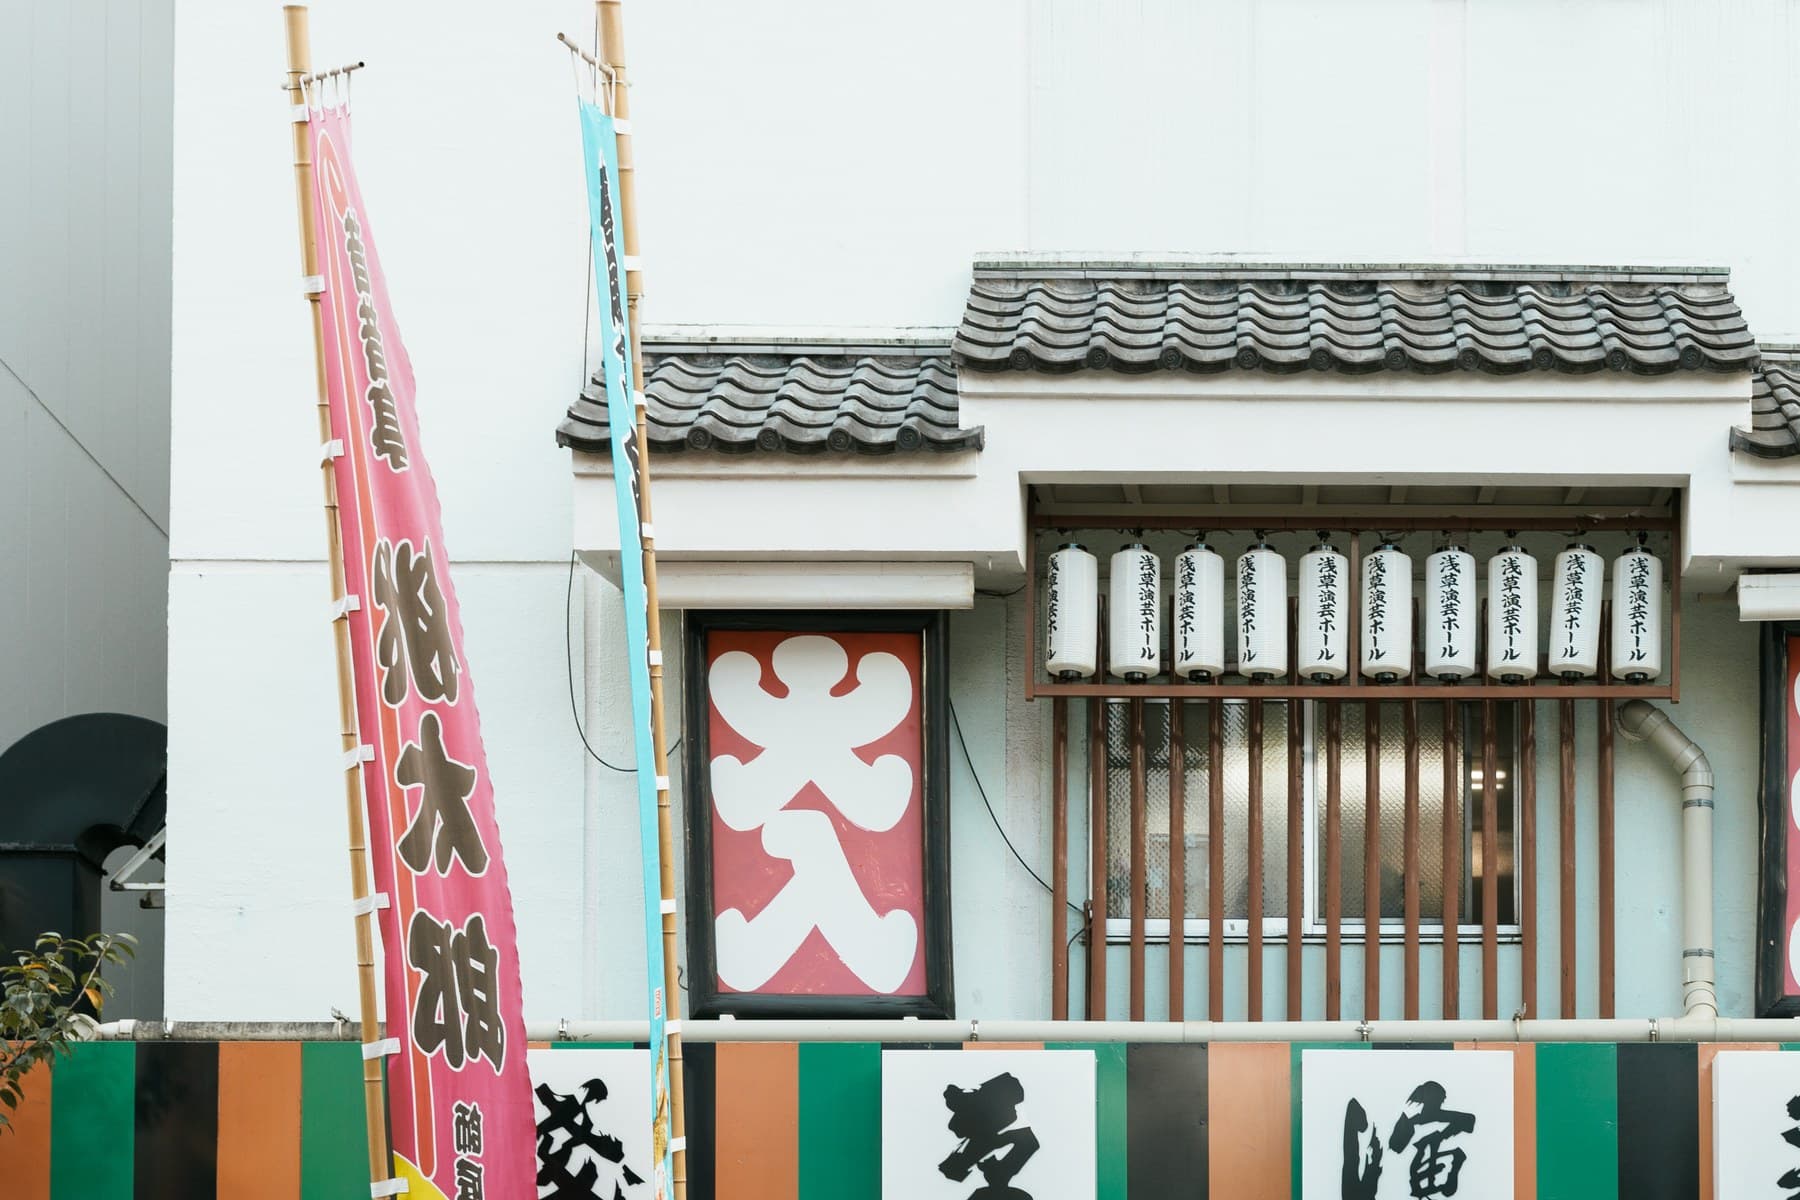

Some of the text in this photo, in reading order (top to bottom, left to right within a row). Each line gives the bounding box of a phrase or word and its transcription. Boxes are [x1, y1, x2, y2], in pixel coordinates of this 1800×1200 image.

[1138, 554, 1156, 660] 浅草演芸ホール
[1179, 555, 1197, 662] 浅草演芸ホール
[1239, 554, 1257, 663] 浅草演芸ホール
[1316, 555, 1340, 662] 浅草演芸ホール
[1368, 555, 1388, 662] 浅草演芸ホール
[1440, 554, 1461, 659] 浅草演芸ホール
[1501, 556, 1523, 662] 浅草演芸ホール
[1564, 553, 1587, 659] 浅草演芸ホール
[1629, 555, 1651, 661] 浅草演芸ホール
